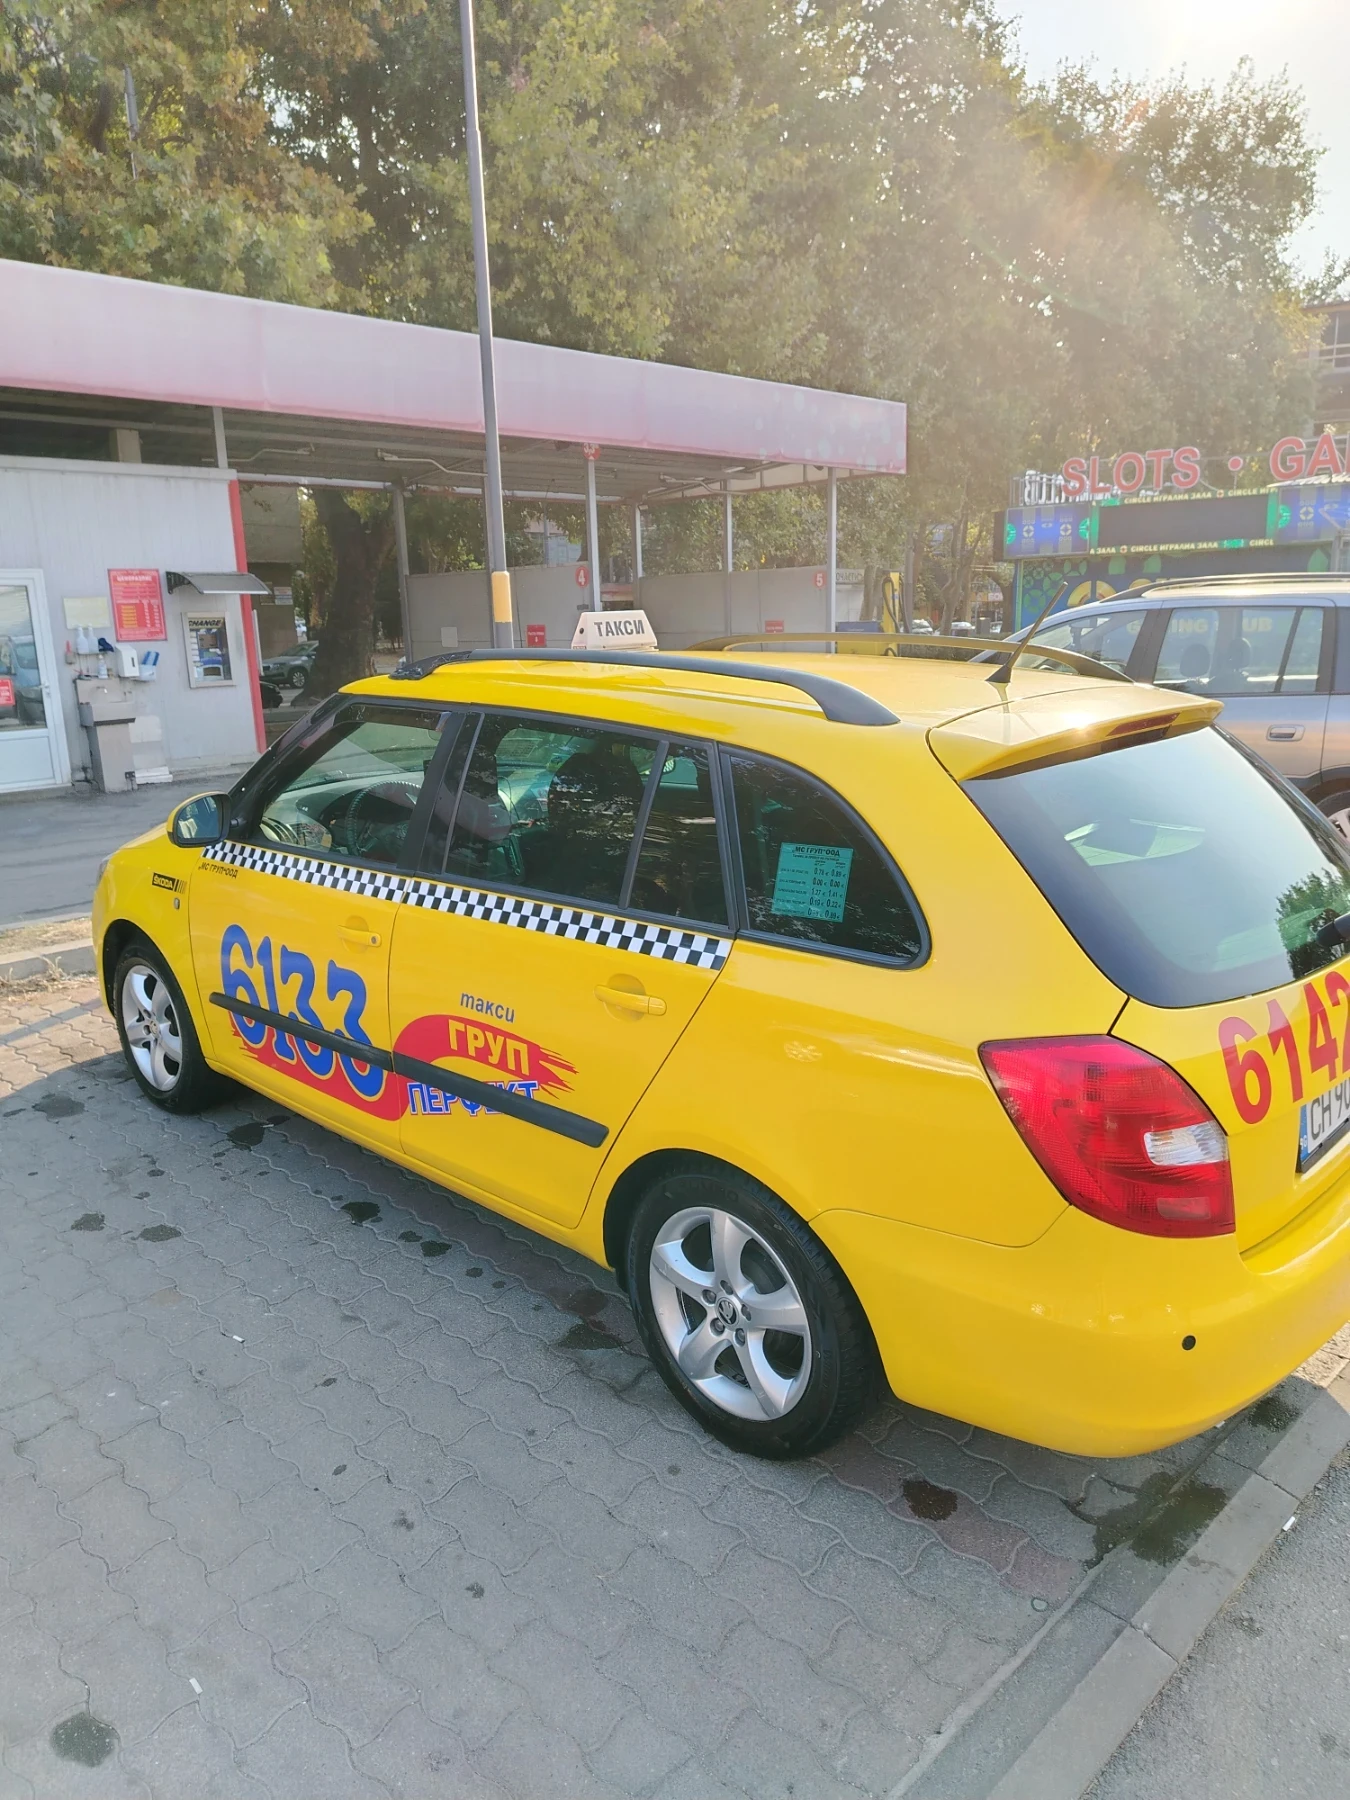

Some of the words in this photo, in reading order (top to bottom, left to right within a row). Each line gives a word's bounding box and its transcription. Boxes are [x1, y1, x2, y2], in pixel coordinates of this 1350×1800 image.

[1061, 446, 1200, 496] SLOTS
[1269, 432, 1350, 481] GA
[1124, 496, 1151, 504] CIRCLE
[1190, 491, 1212, 500] ЗАЛА
[1228, 488, 1257, 497] CIRCLE
[1131, 544, 1158, 552] CIRCLE
[1160, 543, 1195, 551] ИГРАЛНА
[1197, 541, 1218, 549] ЗАЛА
[578, 569, 586, 586] 4
[816, 573, 824, 586] 5
[594, 619, 645, 637] ТАКСИ
[221, 924, 384, 1098] 6133
[460, 992, 515, 1023] такси
[448, 1019, 530, 1076] ГРУП
[1218, 970, 1350, 1124] 6142
